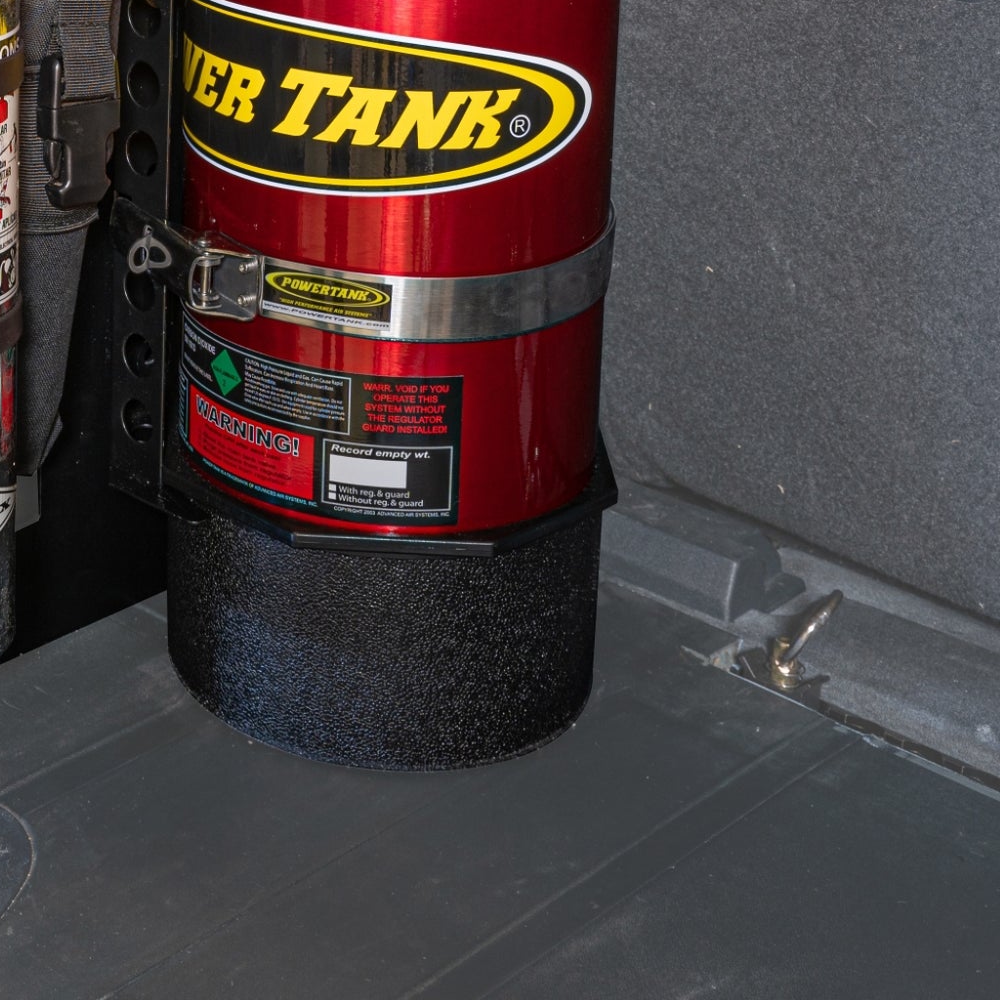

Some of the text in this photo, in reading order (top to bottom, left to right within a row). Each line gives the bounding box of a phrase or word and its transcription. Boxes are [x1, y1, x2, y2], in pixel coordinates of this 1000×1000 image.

[273, 67, 521, 151] TANK
[281, 277, 370, 301] POWERTANK
[363, 383, 450, 393] WARR. VOID IF YOU
[373, 393, 438, 403] OPERATE THIS
[364, 403, 446, 414] SYSTEM WITHOUT
[367, 413, 443, 424] THE REGULATOR
[196, 394, 300, 457] WARNING!
[362, 423, 448, 434] GUARD INSTALLED!
[331, 443, 430, 460] Record empty wt.
[338, 485, 410, 499] With reg. & guard
[338, 494, 424, 508] Without reg. & guard
[333, 505, 363, 515] COPYRIGHT
